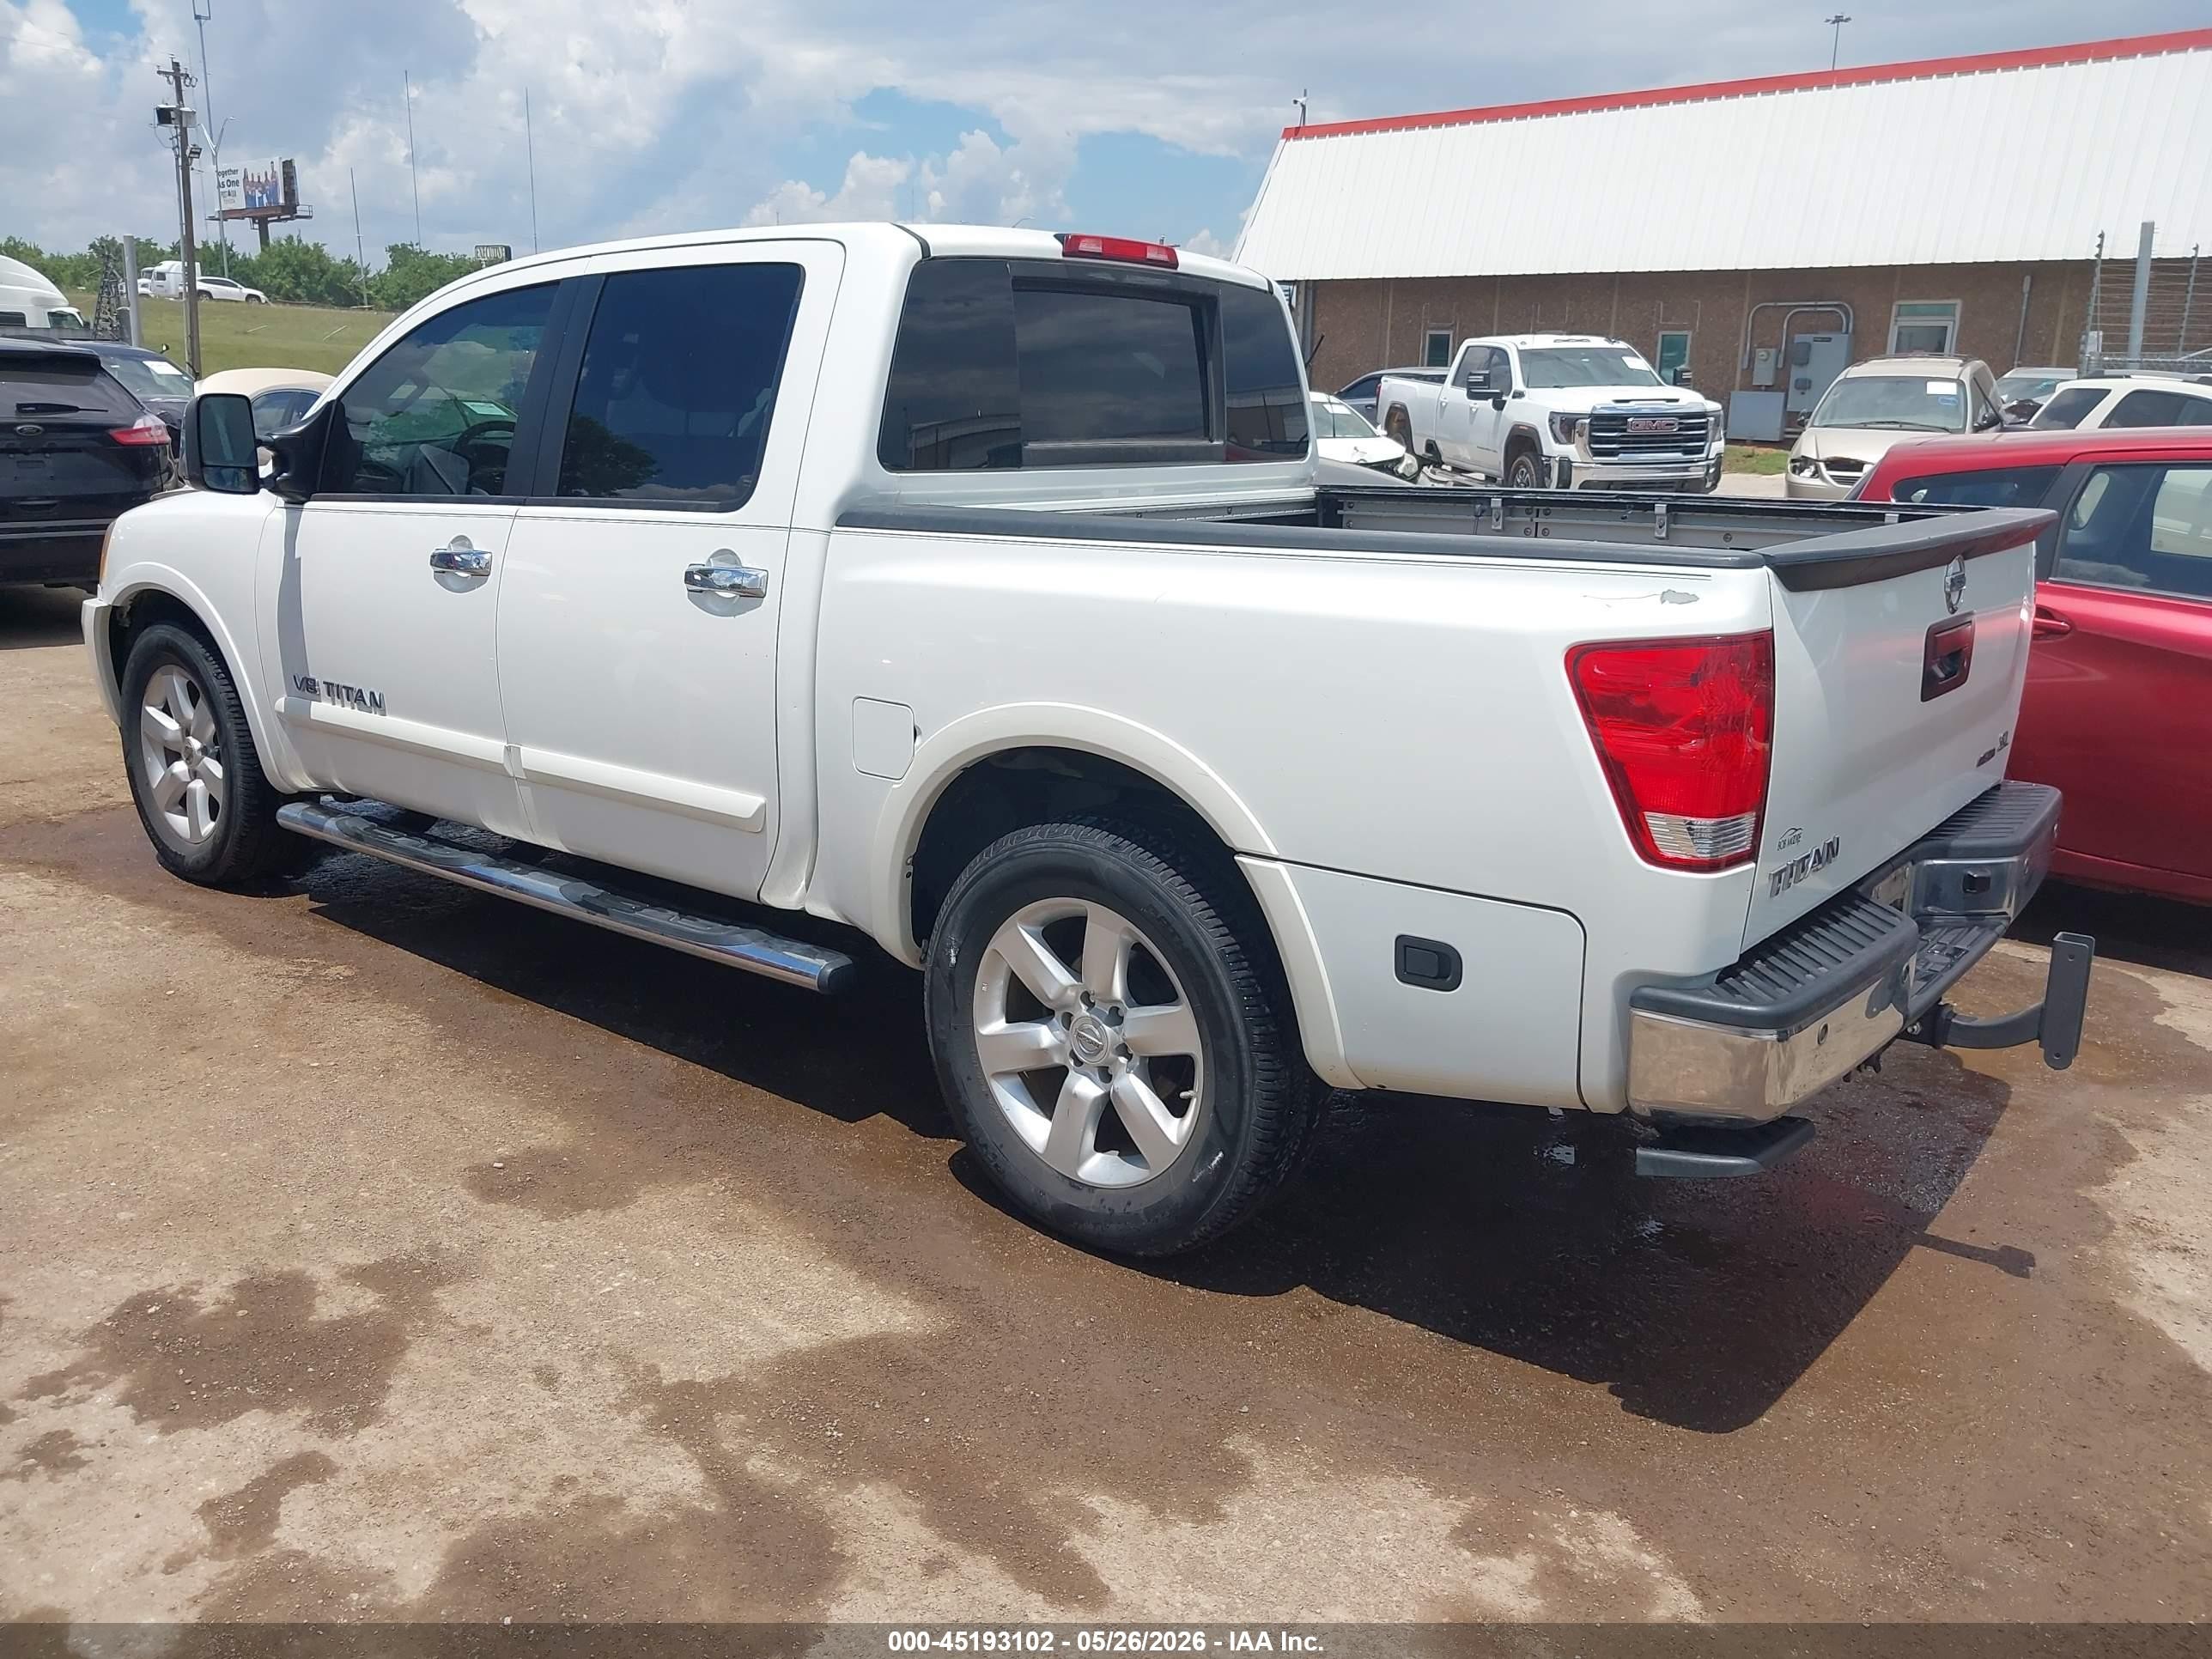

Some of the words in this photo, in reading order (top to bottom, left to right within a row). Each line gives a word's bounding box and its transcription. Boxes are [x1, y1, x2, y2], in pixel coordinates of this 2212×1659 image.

[216, 168, 239, 178] ogether
[227, 179, 240, 188] One
[1632, 421, 1676, 430] GMC
[323, 681, 385, 708] TITAN
[1769, 834, 1839, 898] TITAN
